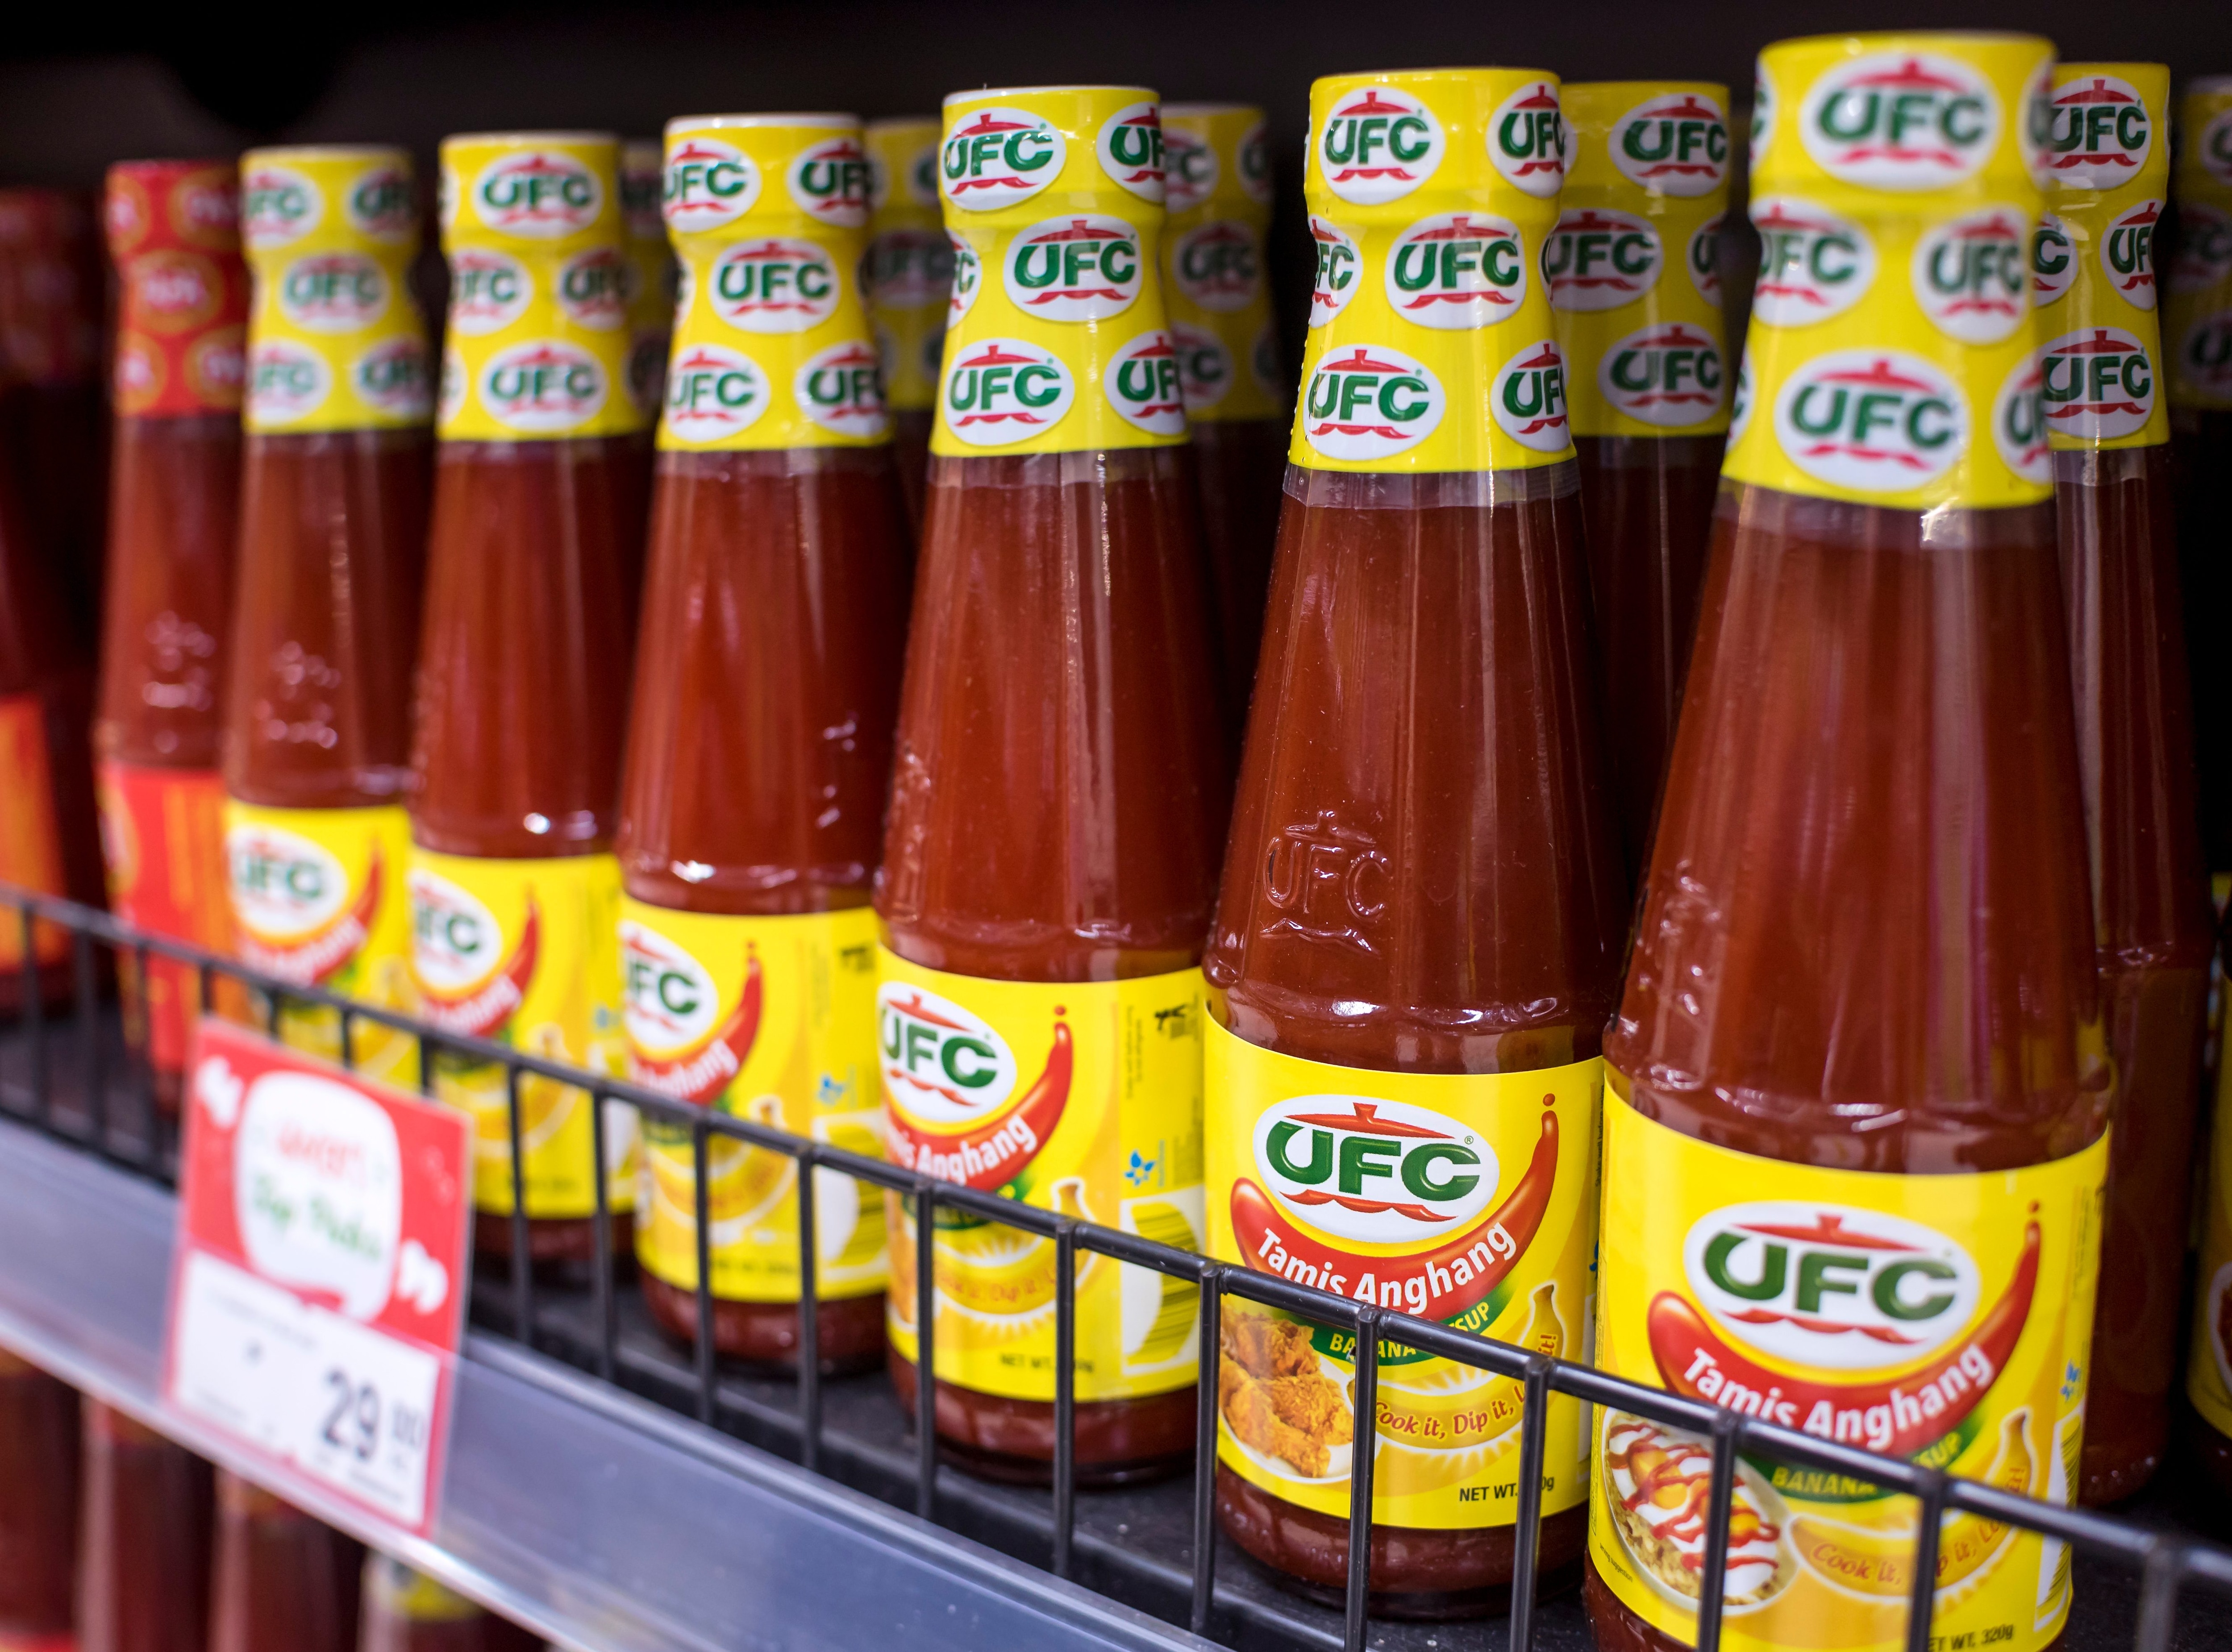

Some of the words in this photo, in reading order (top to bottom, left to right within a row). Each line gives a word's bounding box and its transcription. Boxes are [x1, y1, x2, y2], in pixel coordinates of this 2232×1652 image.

[1324, 117, 1430, 164] UFC
[1622, 118, 1726, 163] UFC
[1817, 91, 1988, 148] UFC
[2052, 106, 2146, 152] UFC
[945, 129, 1053, 179] UFC
[1110, 125, 1166, 167] UF
[482, 172, 591, 211] UFC
[800, 161, 873, 196] UF
[246, 185, 307, 221] FC
[1014, 240, 1136, 288] UFC
[1315, 243, 1354, 290] FC
[1394, 239, 1518, 291] UFC
[1928, 241, 2022, 294] UFC
[2108, 227, 2151, 270] UF
[285, 271, 380, 306] UFC
[451, 269, 517, 303] FC
[562, 268, 627, 300] UF
[719, 262, 830, 301] UFC
[489, 365, 595, 402] UFC
[808, 368, 886, 401] UF
[949, 363, 1061, 411] UFC
[1117, 360, 1180, 402] UF
[1610, 350, 1720, 391] UFC
[2044, 355, 2150, 403] UFC
[1307, 371, 1429, 421] UFC
[1790, 384, 1952, 449] UFC
[1263, 835, 1392, 922] UFC
[414, 906, 480, 953] FC
[628, 961, 699, 1015] FC
[1266, 1119, 1480, 1201] UFC
[1258, 1229, 1347, 1296] Tamis
[1353, 1222, 1516, 1314] Anghang
[1703, 1231, 1957, 1321] UFC
[1329, 1333, 1416, 1358] BAANA
[1448, 1302, 1490, 1332] SUP
[1376, 1402, 1418, 1434] Cook
[1424, 1418, 1445, 1439] it,
[1453, 1412, 1487, 1433] Dip
[1492, 1400, 1514, 1419] it,
[1684, 1348, 1794, 1425] Tamis
[1803, 1344, 1993, 1452] Anghang
[1912, 1432, 1961, 1469] SUP
[1459, 1486, 1489, 1501] NET
[1494, 1484, 1518, 1498] WT.
[1541, 1477, 1554, 1492] 0g
[1813, 1543, 1870, 1580] Cook
[1877, 1561, 1901, 1585] it,
[1928, 1637, 1945, 1651] ET
[1982, 1625, 2014, 1644] 320g
